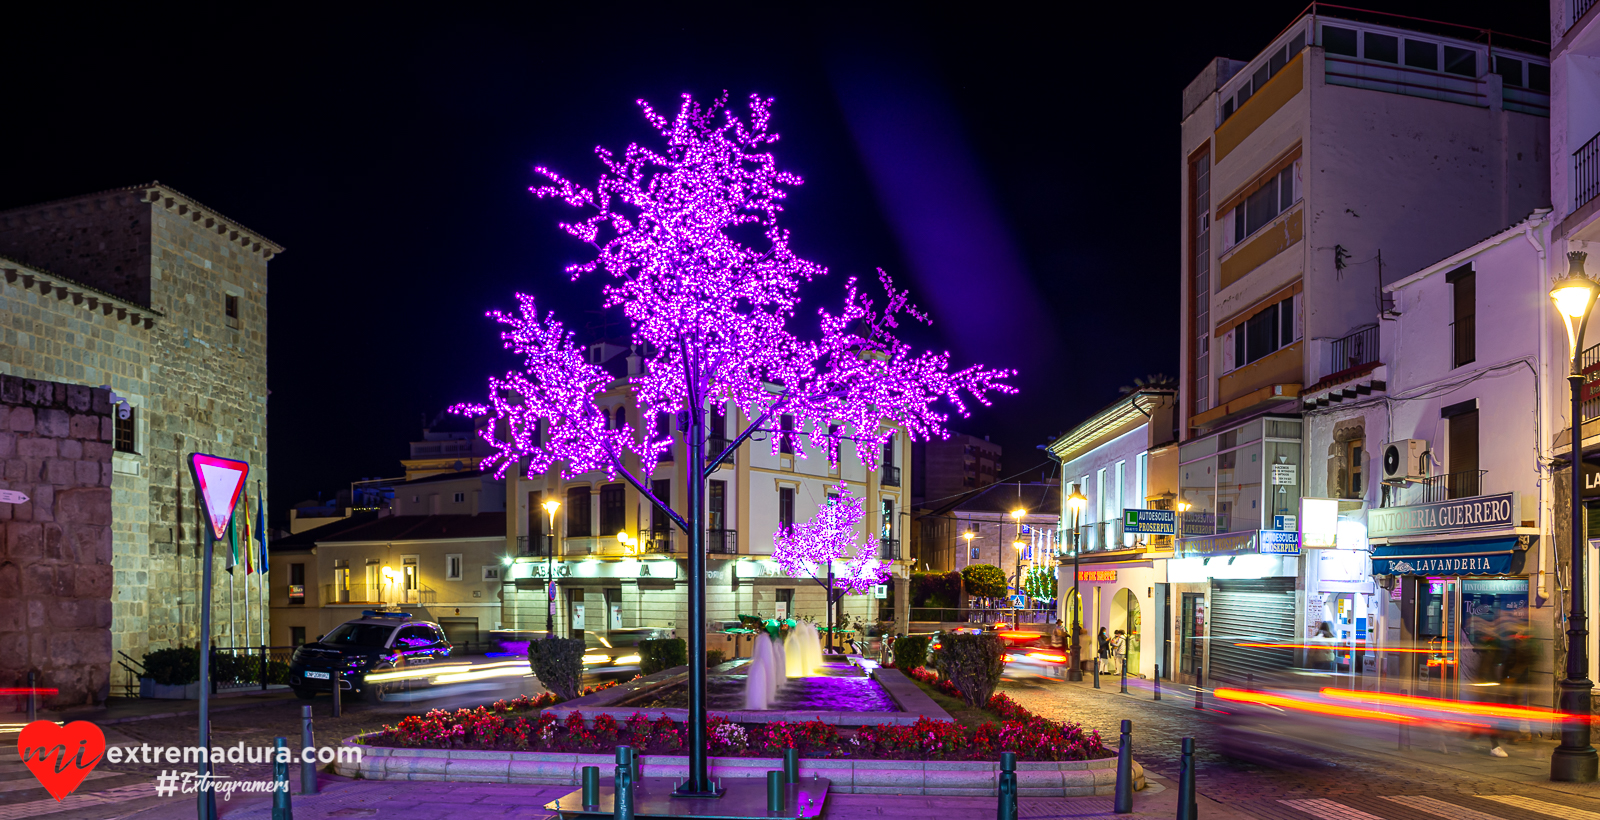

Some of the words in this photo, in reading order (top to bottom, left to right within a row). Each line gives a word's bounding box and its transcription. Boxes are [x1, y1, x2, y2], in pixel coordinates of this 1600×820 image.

[1138, 511, 1174, 522] AUTOESCUELA
[1372, 508, 1437, 533] TINTORERIA
[1439, 499, 1511, 527] GUERRERO
[1138, 522, 1174, 533] PROSERPINA
[1262, 532, 1299, 543] AUTOESCUELA
[1262, 543, 1299, 553] PROSERPINA
[1417, 557, 1491, 571] LAVANDERIA
